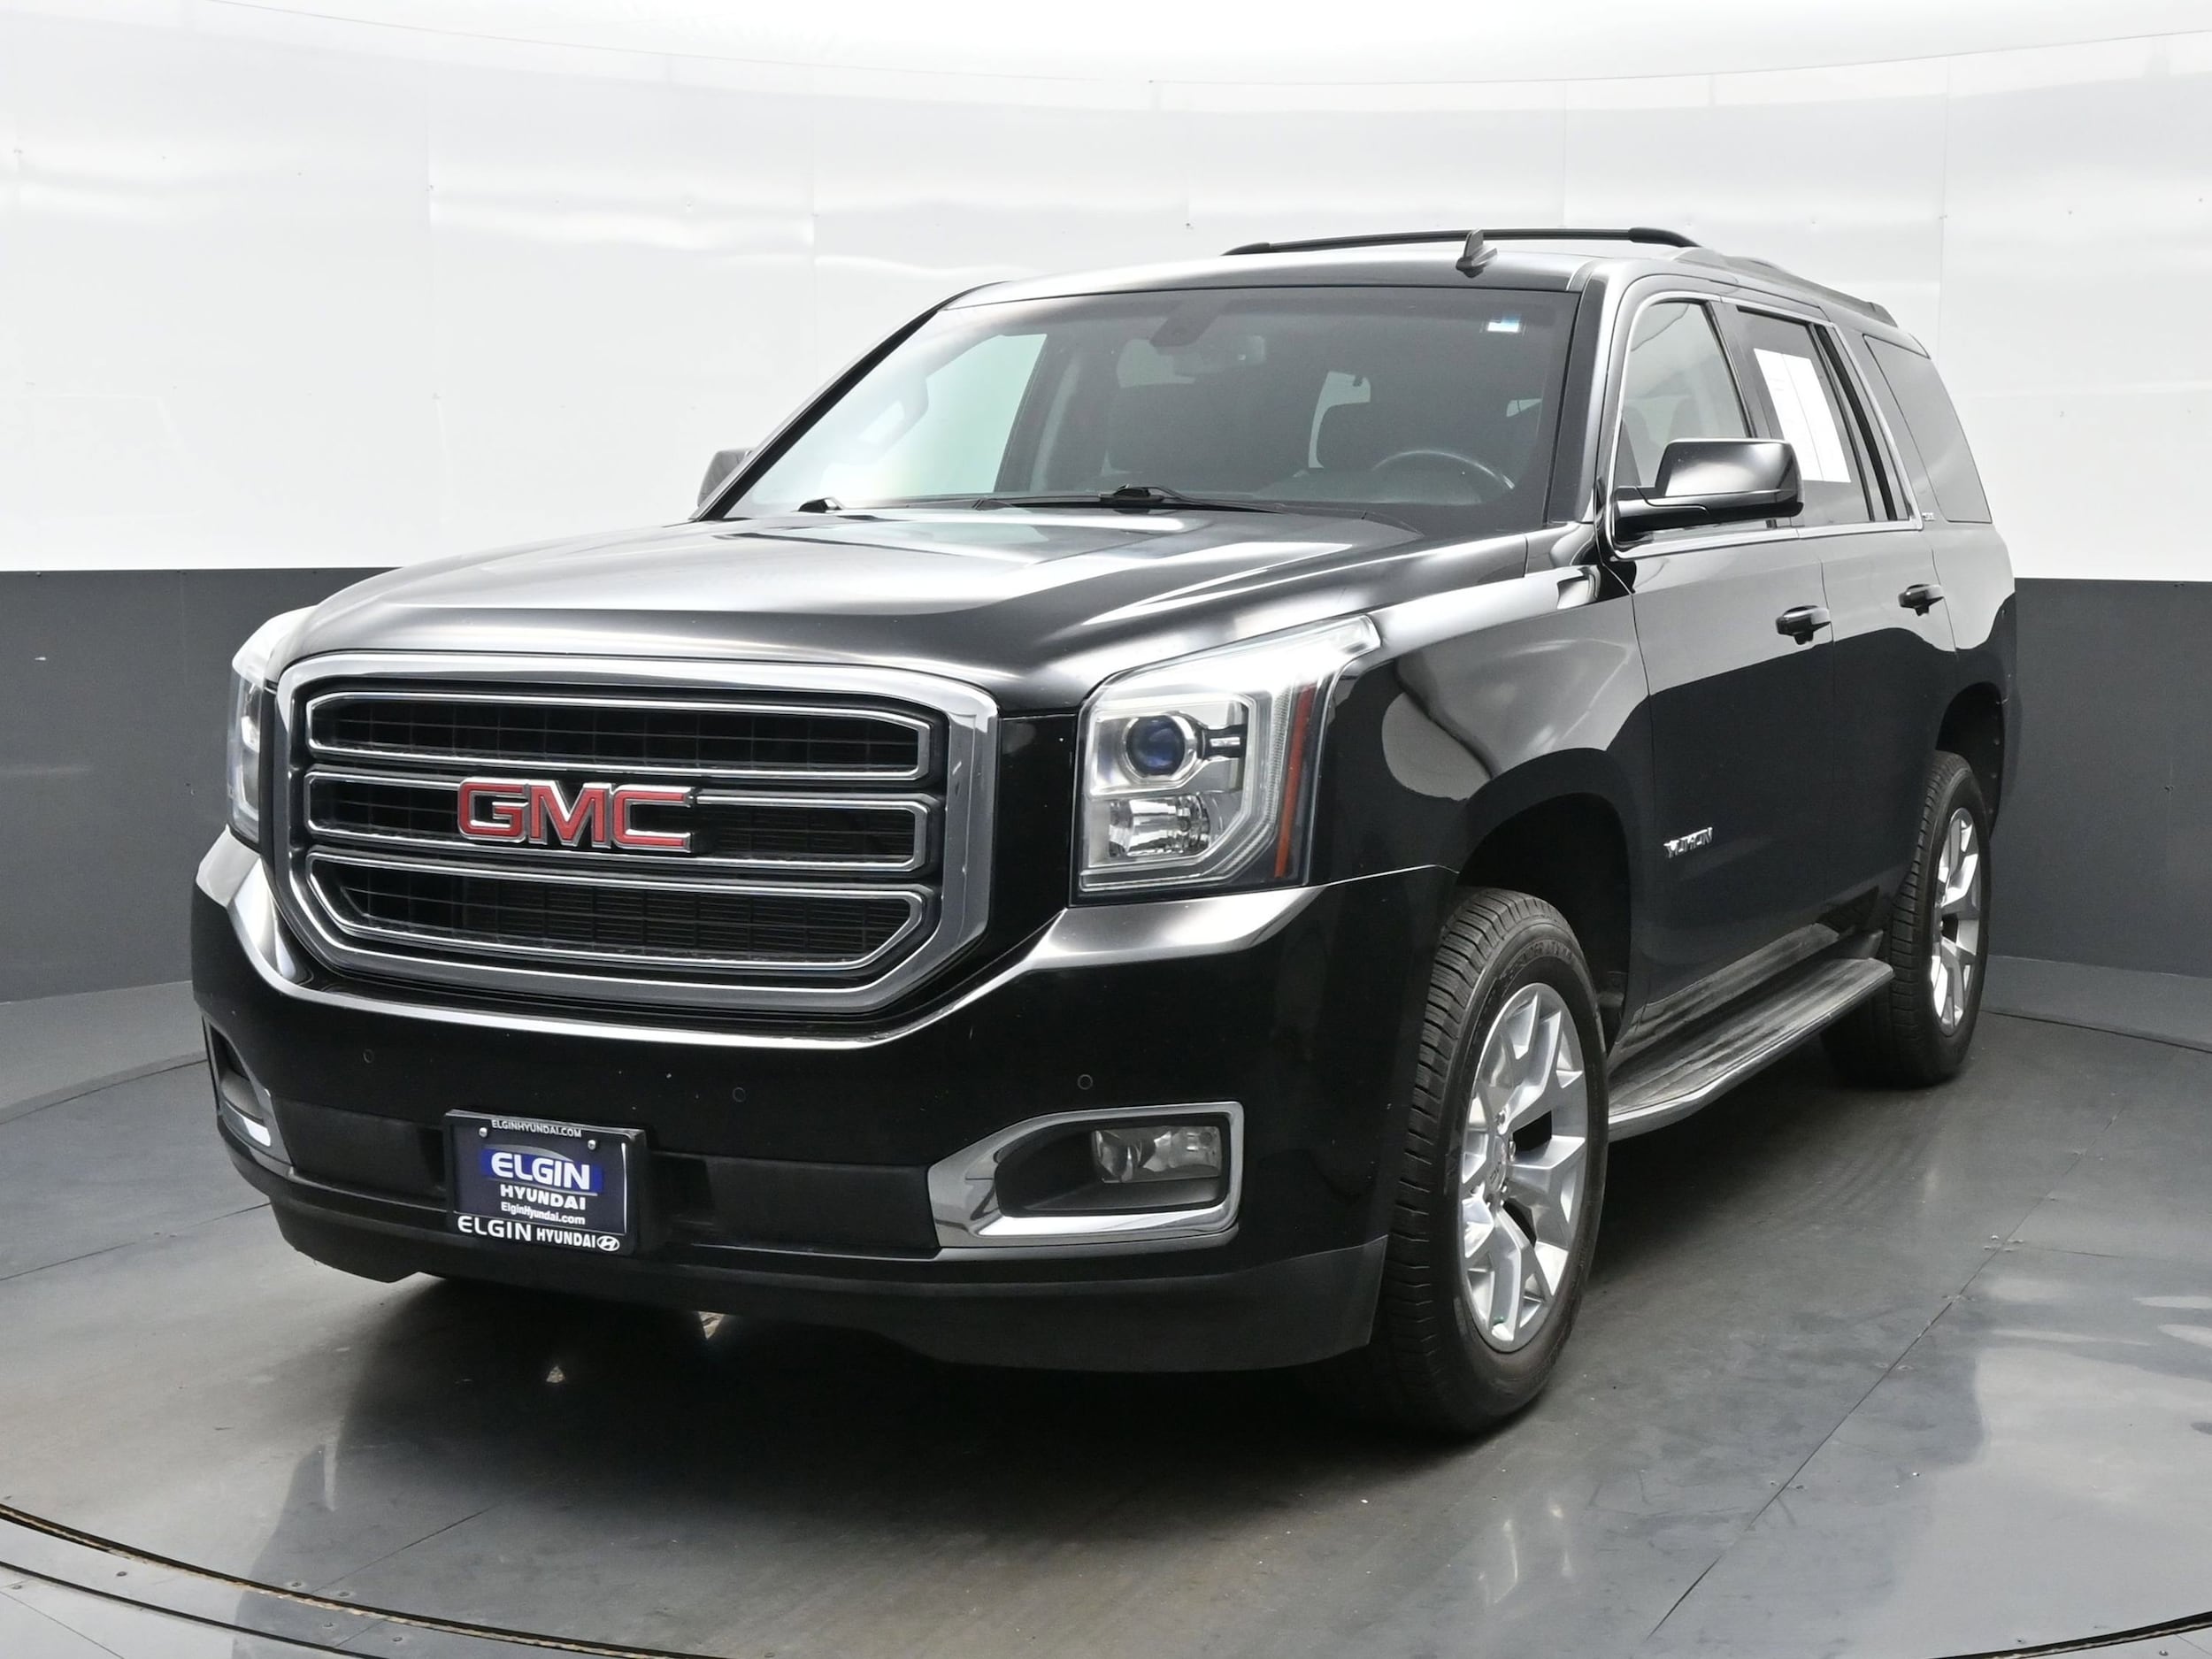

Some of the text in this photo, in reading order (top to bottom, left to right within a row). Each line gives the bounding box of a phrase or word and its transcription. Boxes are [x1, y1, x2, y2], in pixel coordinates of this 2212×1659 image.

[457, 777, 693, 853] GMC
[491, 1119, 582, 1139] ELGINHYUNDAI.COM
[491, 1151, 590, 1190] ELGIN
[500, 1184, 587, 1210] HYUNDAI
[501, 1202, 586, 1225] ElginHyundai.com
[457, 1215, 596, 1248] ELGIN HYUNDAI
